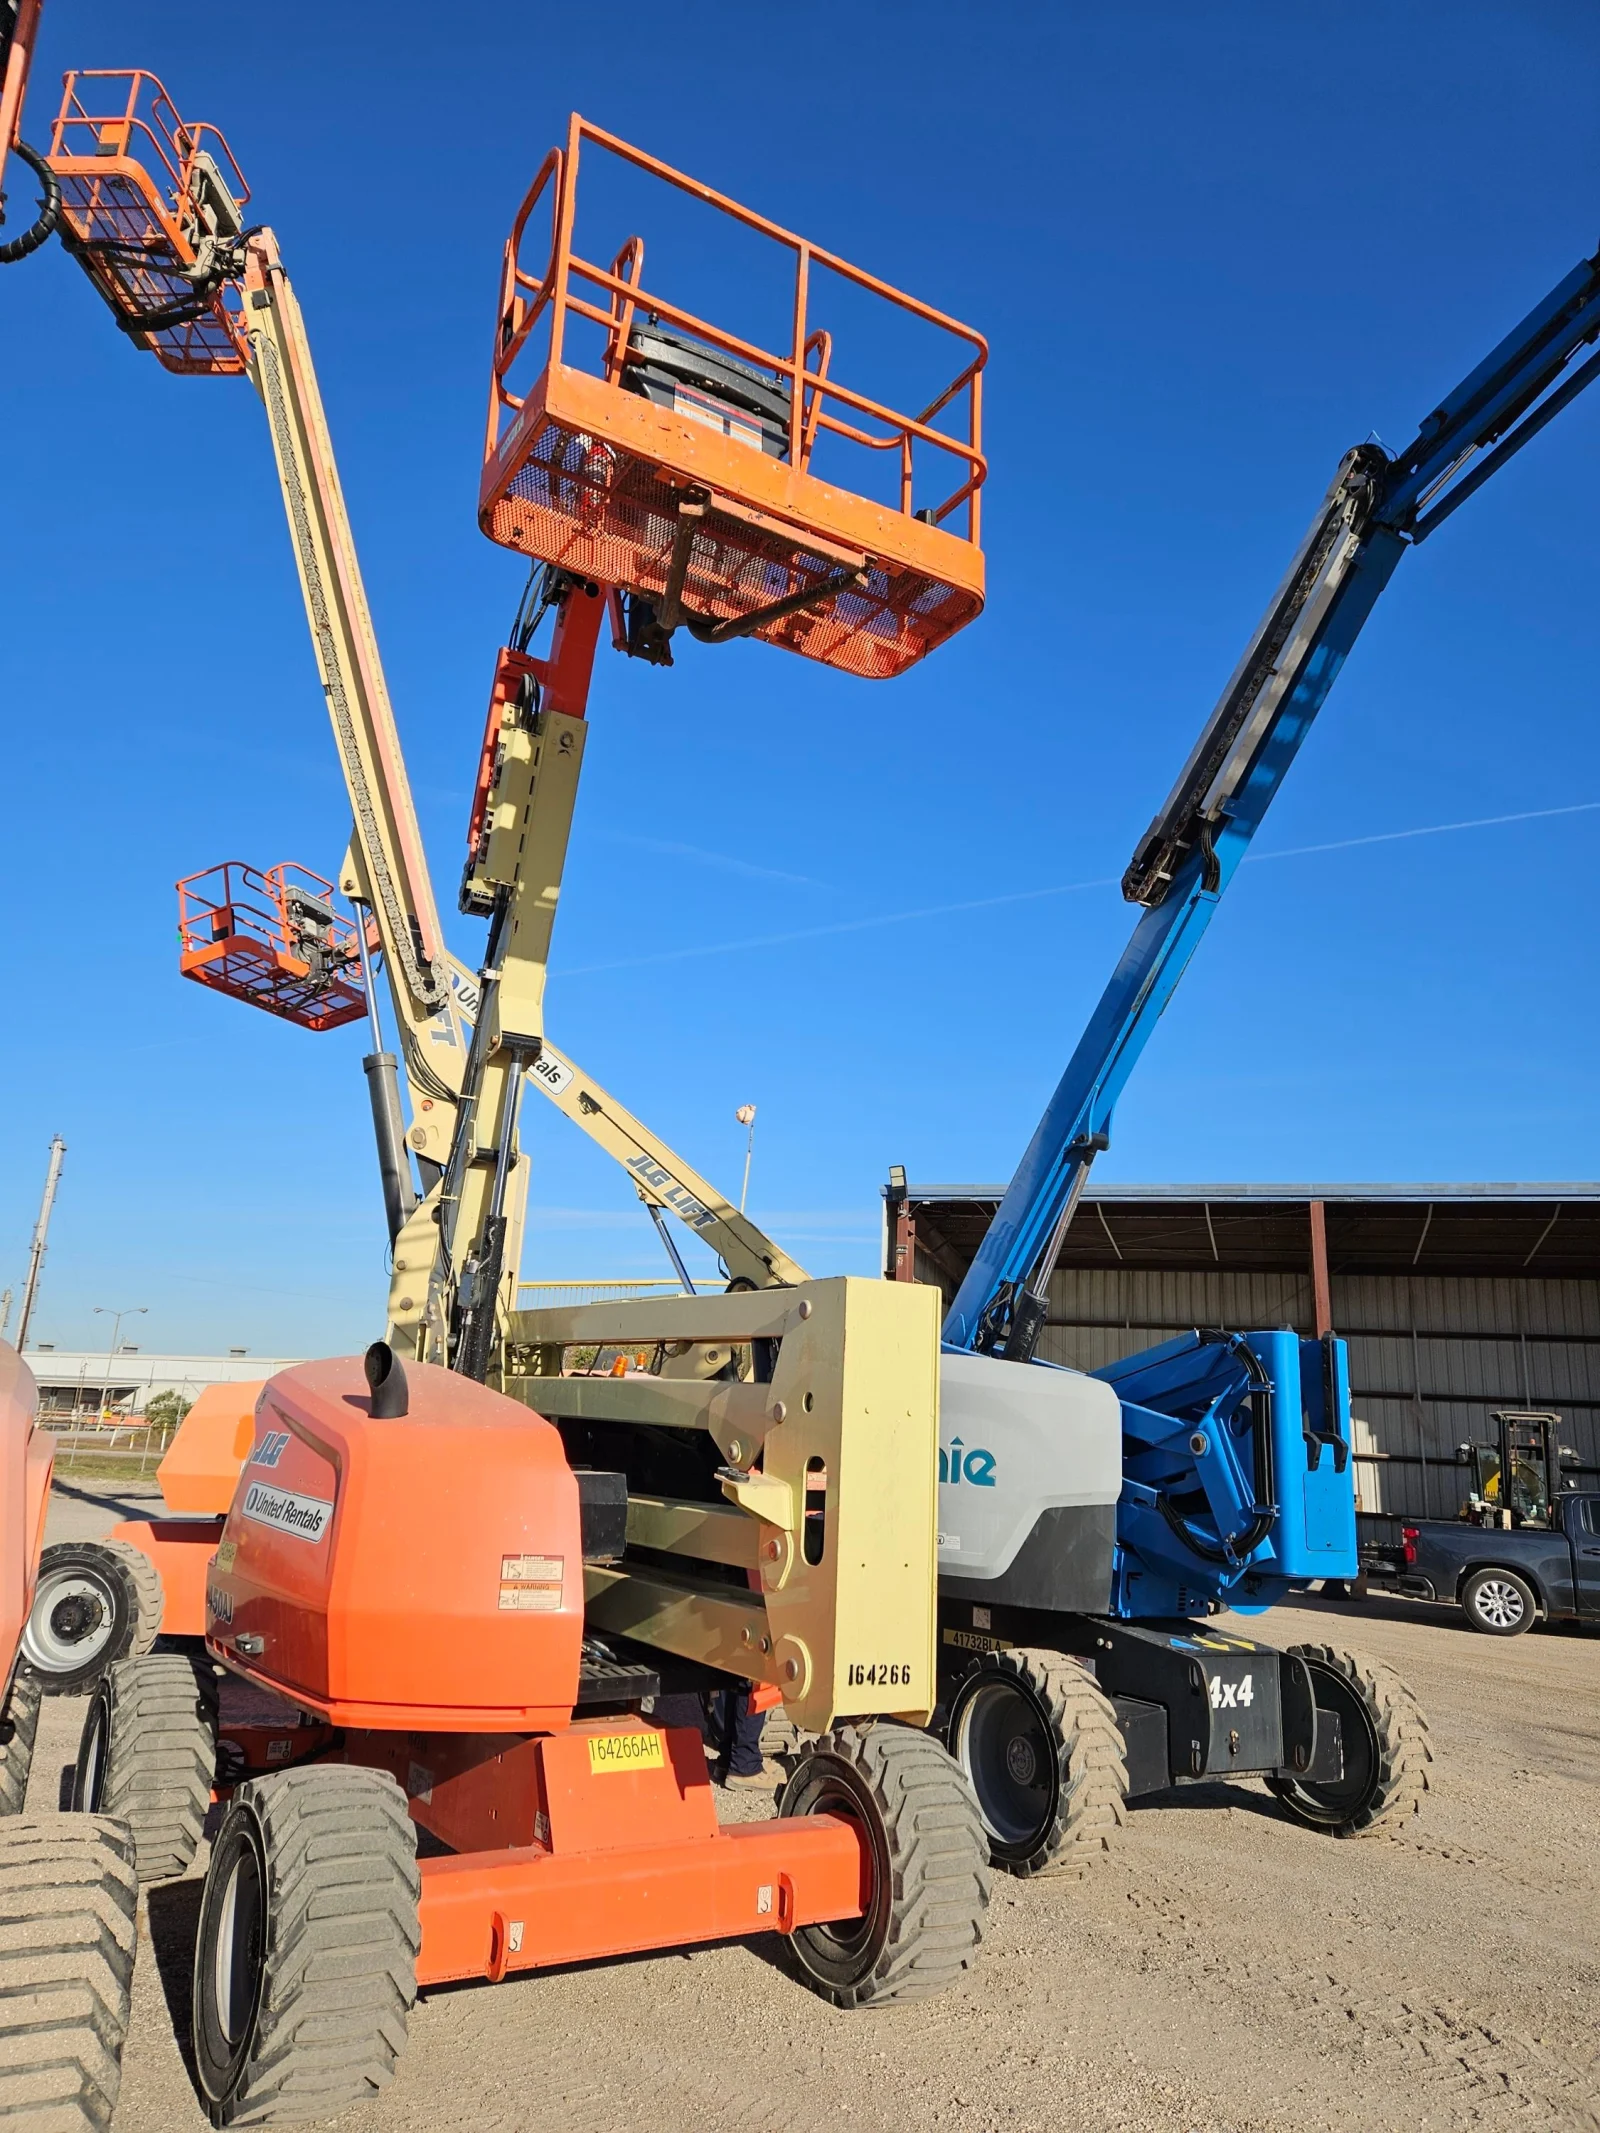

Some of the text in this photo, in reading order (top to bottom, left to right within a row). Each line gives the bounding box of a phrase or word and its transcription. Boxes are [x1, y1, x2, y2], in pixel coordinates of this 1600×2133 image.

[625, 1154, 719, 1228] JLG LIFT
[251, 1431, 291, 1468] JLG
[255, 1491, 323, 1532] United Rentals
[520, 1583, 550, 1591] WARNING
[952, 1632, 1001, 1651] 41732BLA
[848, 1664, 911, 1687] 164266
[1209, 1674, 1254, 1709] 4x4
[588, 1734, 660, 1761] 164266AH
